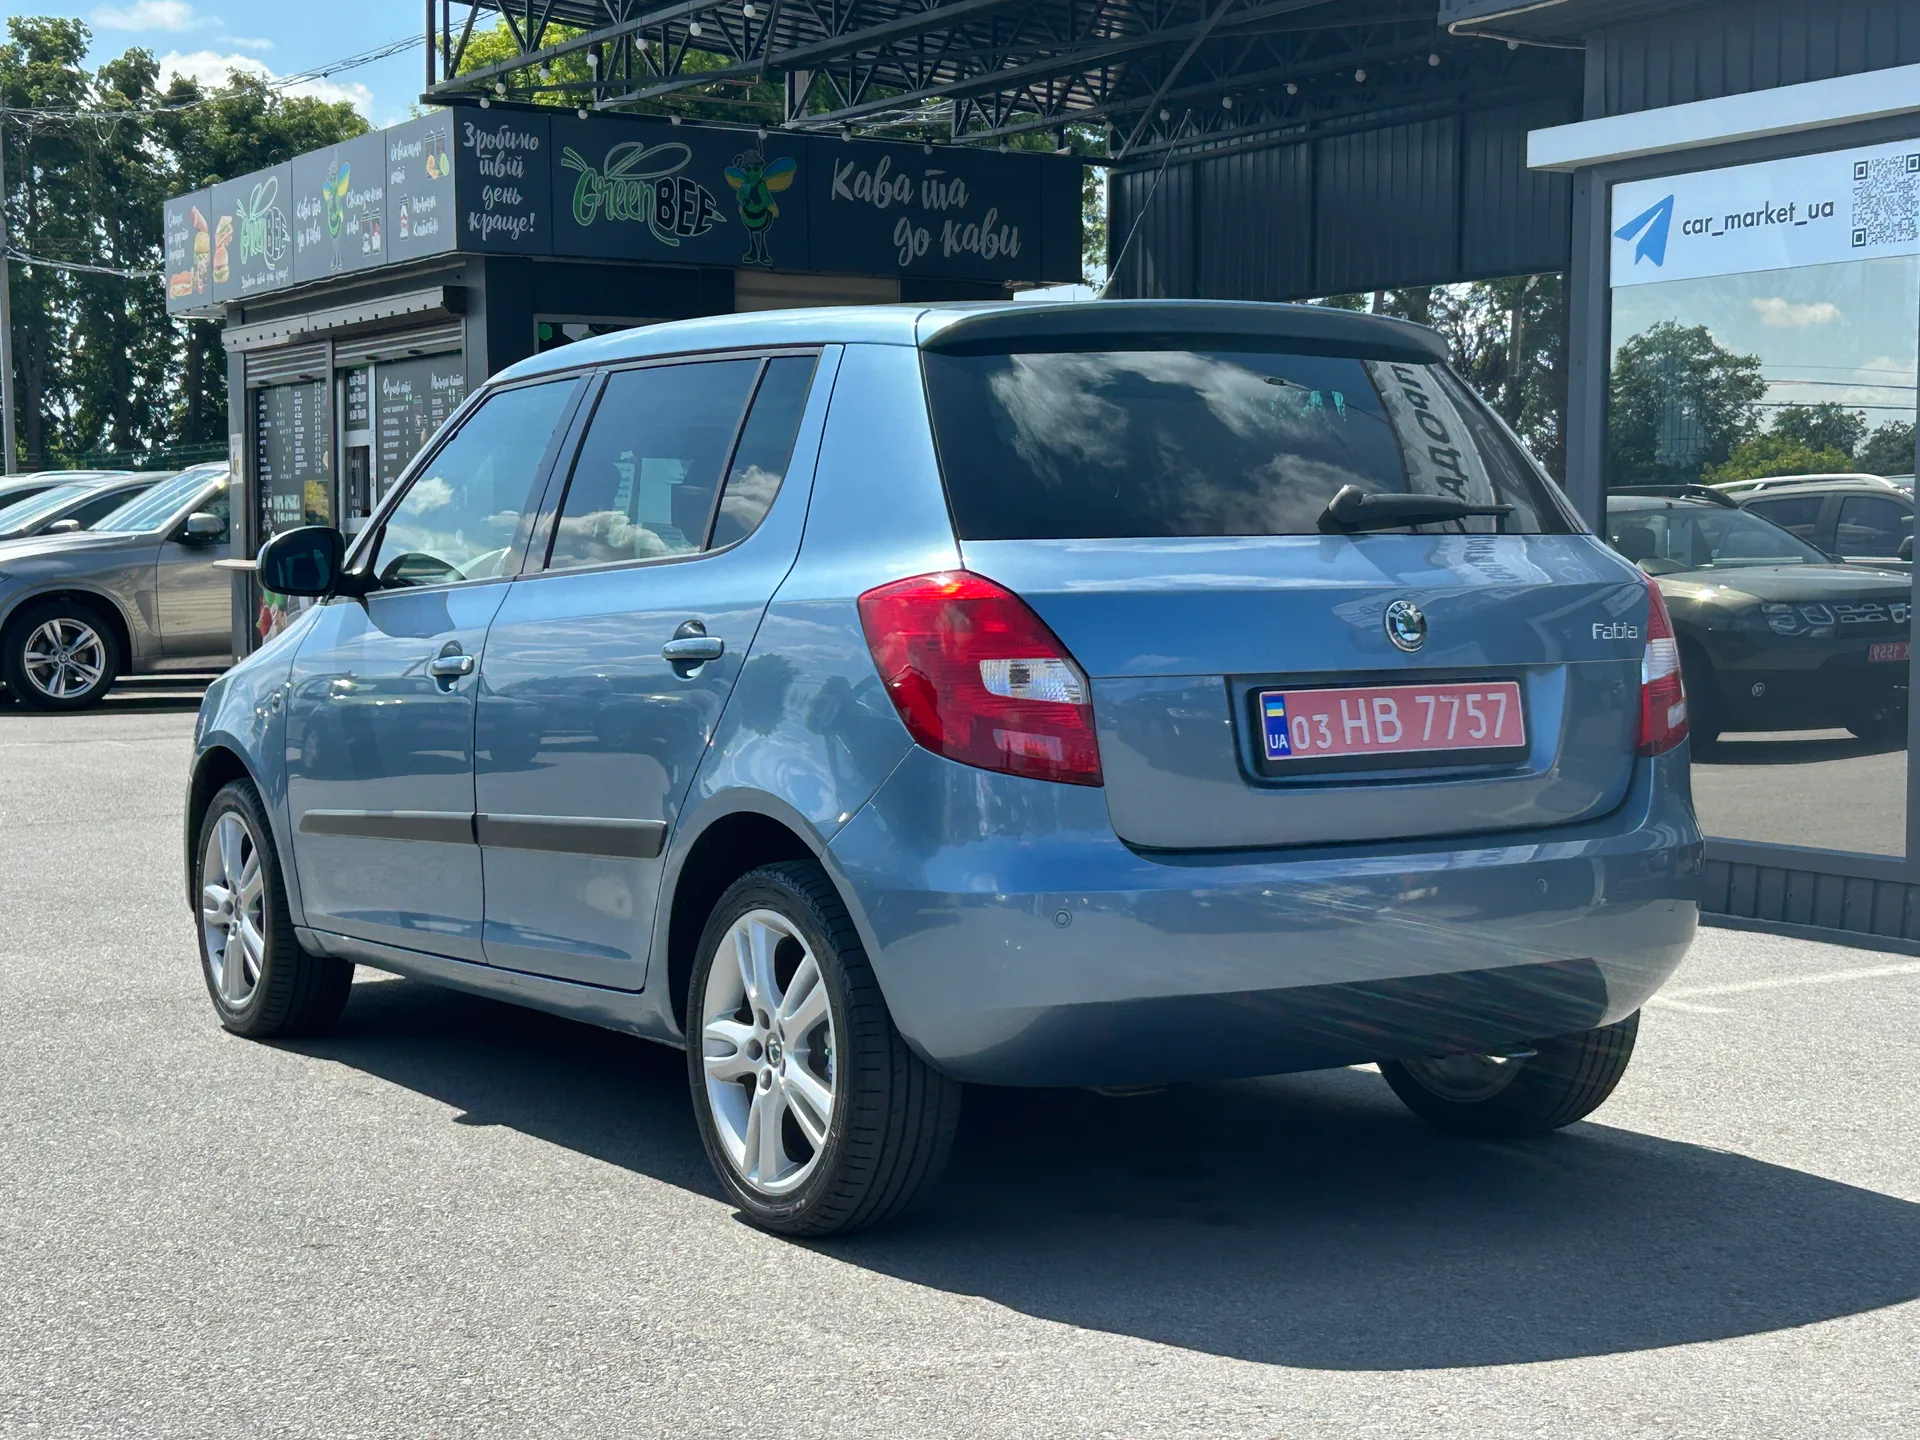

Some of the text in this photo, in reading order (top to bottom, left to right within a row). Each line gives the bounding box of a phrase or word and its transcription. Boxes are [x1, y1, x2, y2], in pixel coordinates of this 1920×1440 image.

[463, 122, 540, 158] Зробимо
[479, 151, 525, 179] твій
[482, 185, 523, 211] день
[831, 155, 970, 211] Кава та
[467, 211, 536, 242] краще!
[1682, 200, 1834, 237] car_market_ua
[893, 207, 1022, 267] до кави
[1591, 621, 1639, 640] Fabia
[1291, 692, 1507, 750] 03 HB 7757
[1268, 733, 1289, 749] UA
